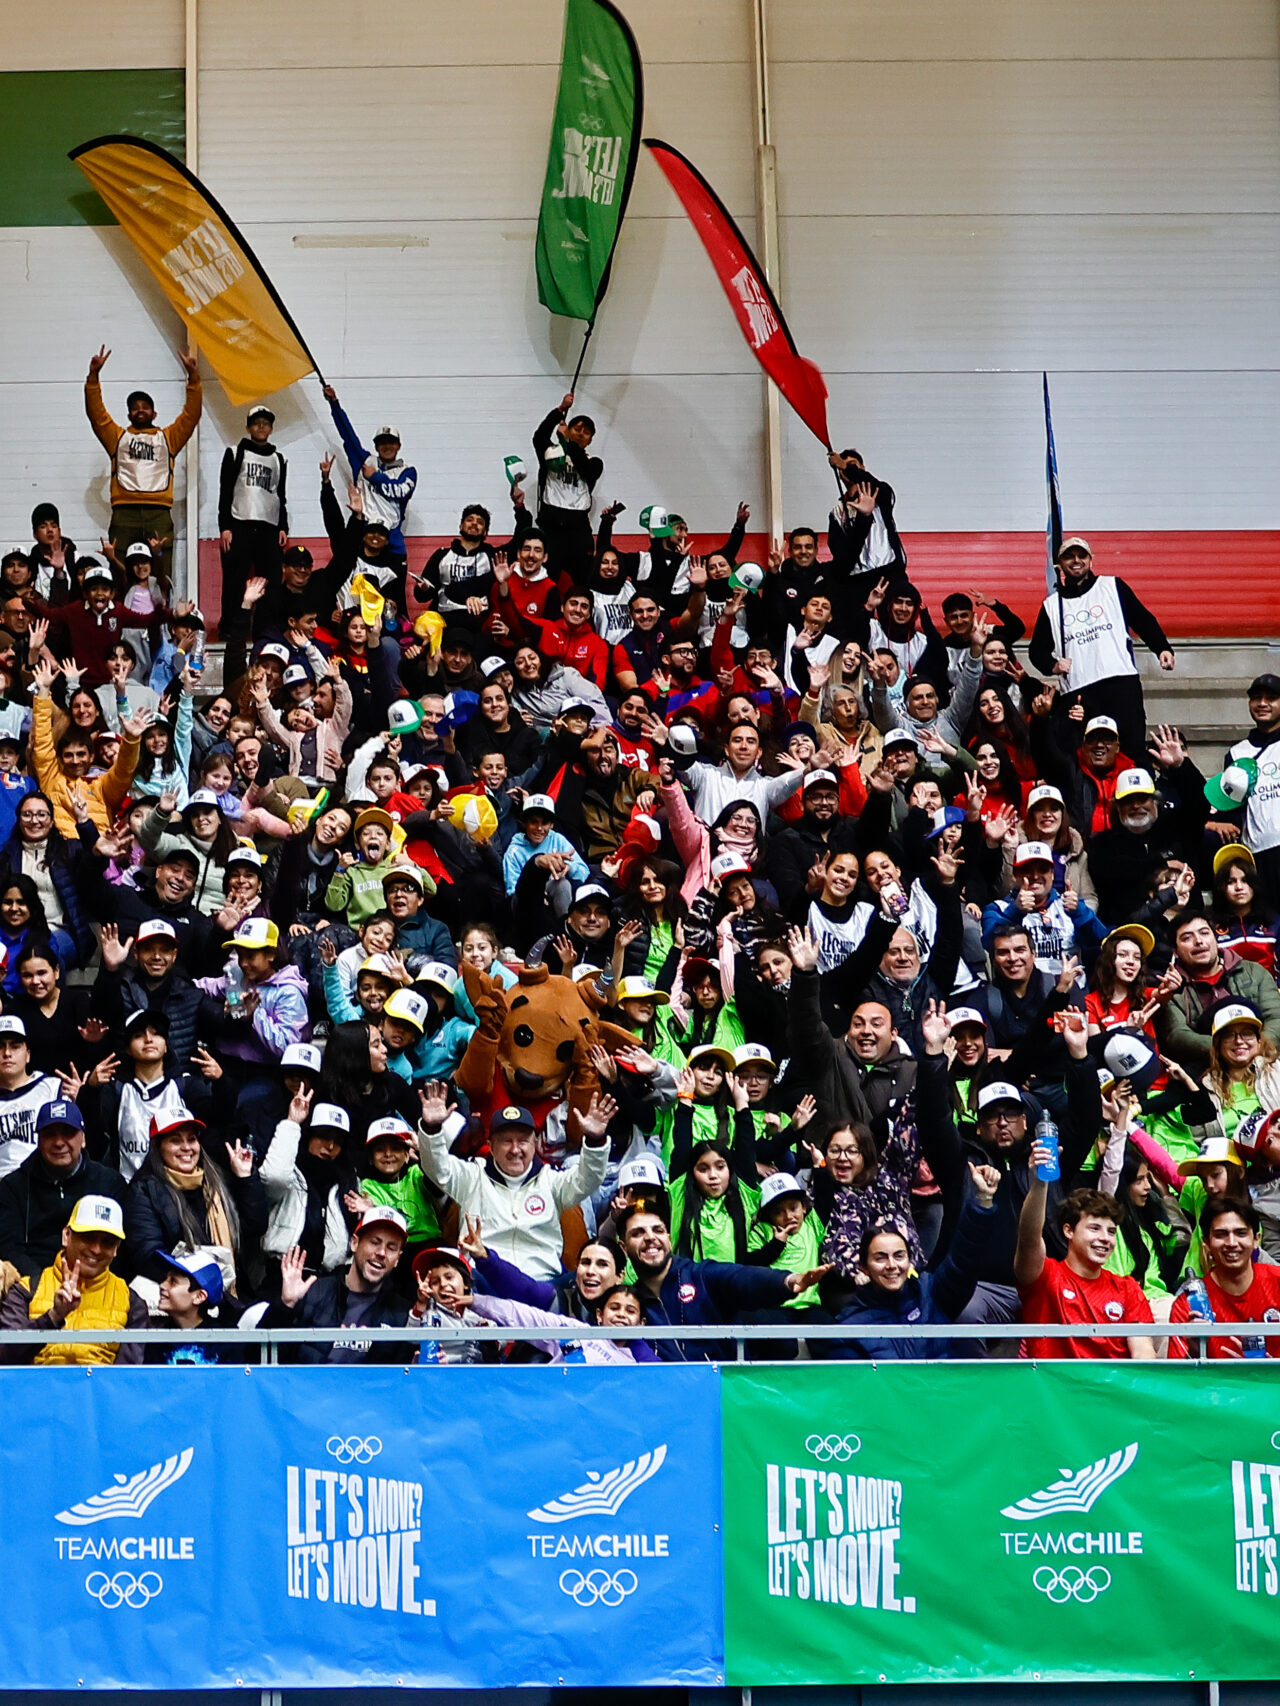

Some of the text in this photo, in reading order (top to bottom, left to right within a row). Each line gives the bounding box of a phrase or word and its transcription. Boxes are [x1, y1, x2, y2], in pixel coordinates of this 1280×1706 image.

[1077, 632, 1100, 645] CHILE
[287, 1466, 423, 1546] LET'S MOVE?
[767, 1464, 903, 1545] LET'S MOVE?
[55, 1538, 195, 1560] TEAMCHILE
[527, 1535, 670, 1558] TEAMCHILE
[769, 1528, 916, 1613] LET'S MOVE.
[1000, 1532, 1143, 1555] TEAMCHILE
[1235, 1538, 1279, 1597] LET'S
[288, 1530, 437, 1617] LET'S MOVE.
